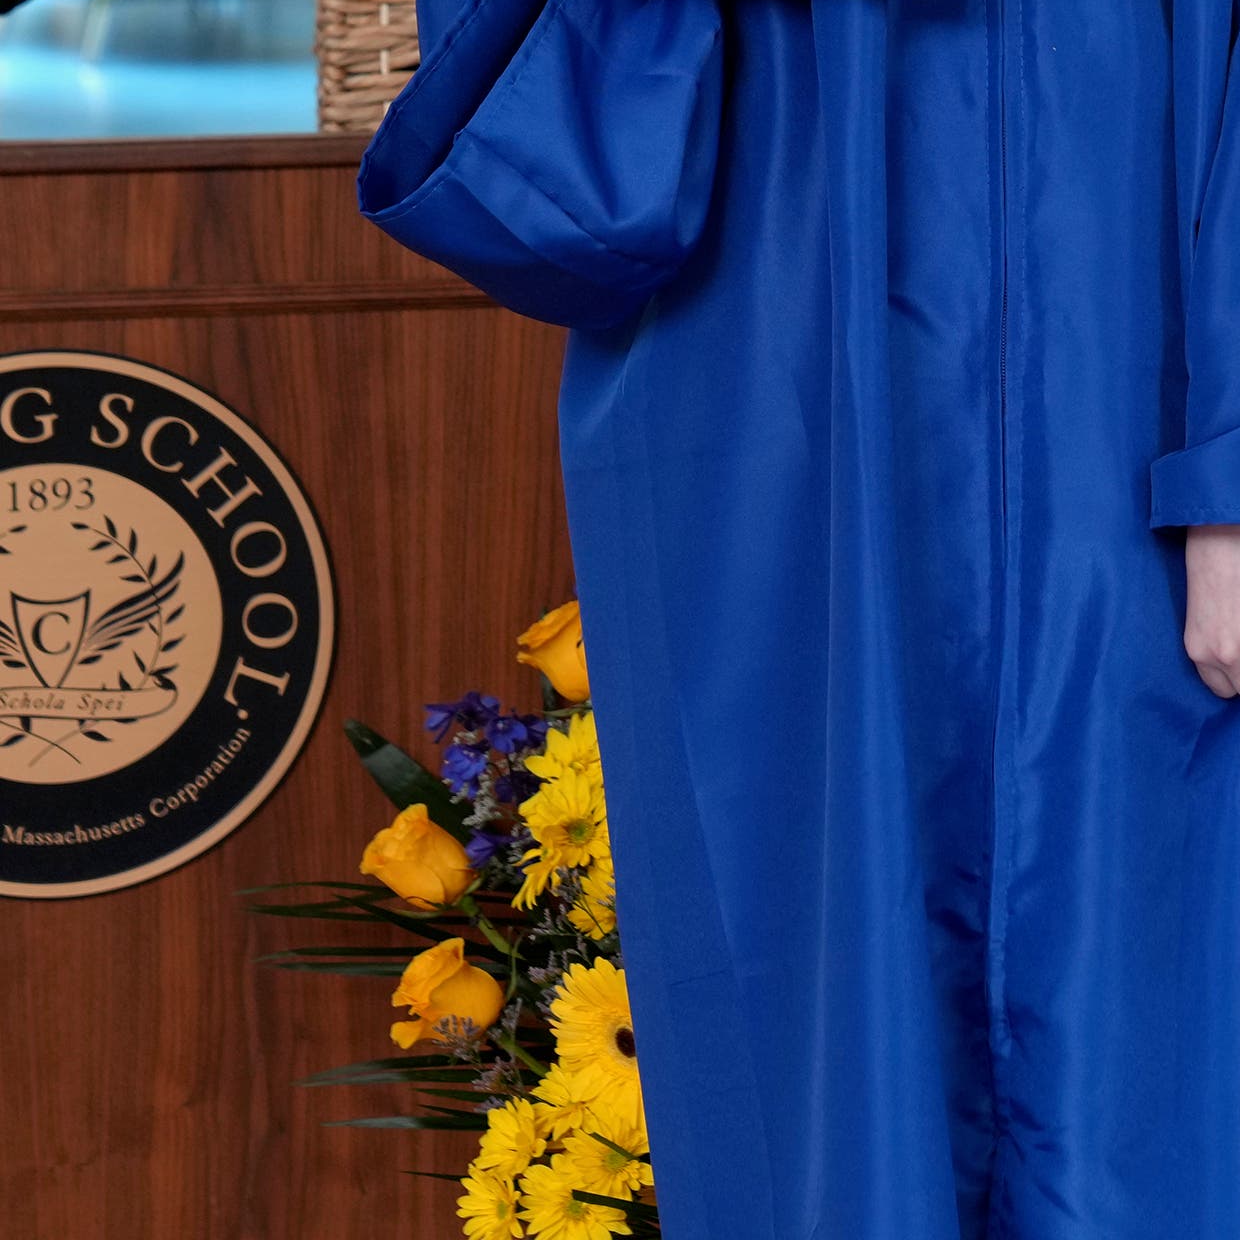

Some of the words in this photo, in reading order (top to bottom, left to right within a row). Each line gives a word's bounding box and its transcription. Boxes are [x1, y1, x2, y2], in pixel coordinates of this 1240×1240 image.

[8, 477, 96, 512] 1893
[89, 392, 299, 707] SCHOOL
[31, 611, 71, 655] C
[77, 693, 126, 716] Spei
[1, 811, 147, 847] Massachusetts
[148, 725, 252, 819] Corporation
